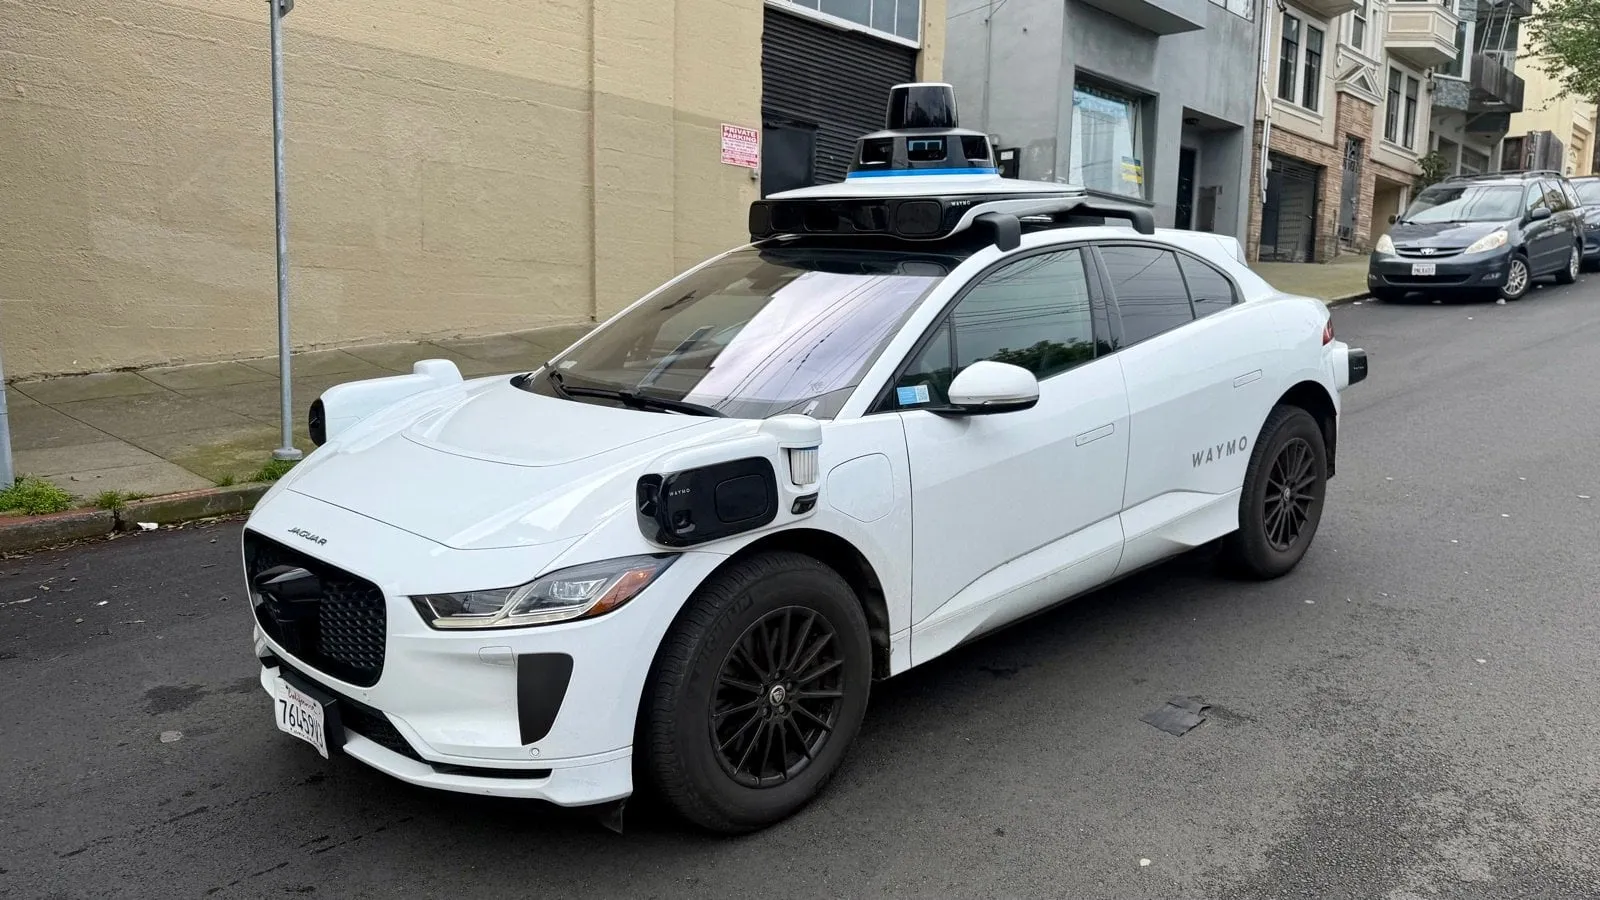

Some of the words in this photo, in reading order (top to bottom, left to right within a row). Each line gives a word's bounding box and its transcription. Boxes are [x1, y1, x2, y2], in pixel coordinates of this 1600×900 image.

[723, 132, 757, 143] PARKING
[724, 126, 757, 138] PRIVATE
[1192, 435, 1248, 468] WAYMO
[669, 488, 691, 497] WAYMO
[287, 527, 328, 546] JAGUAR
